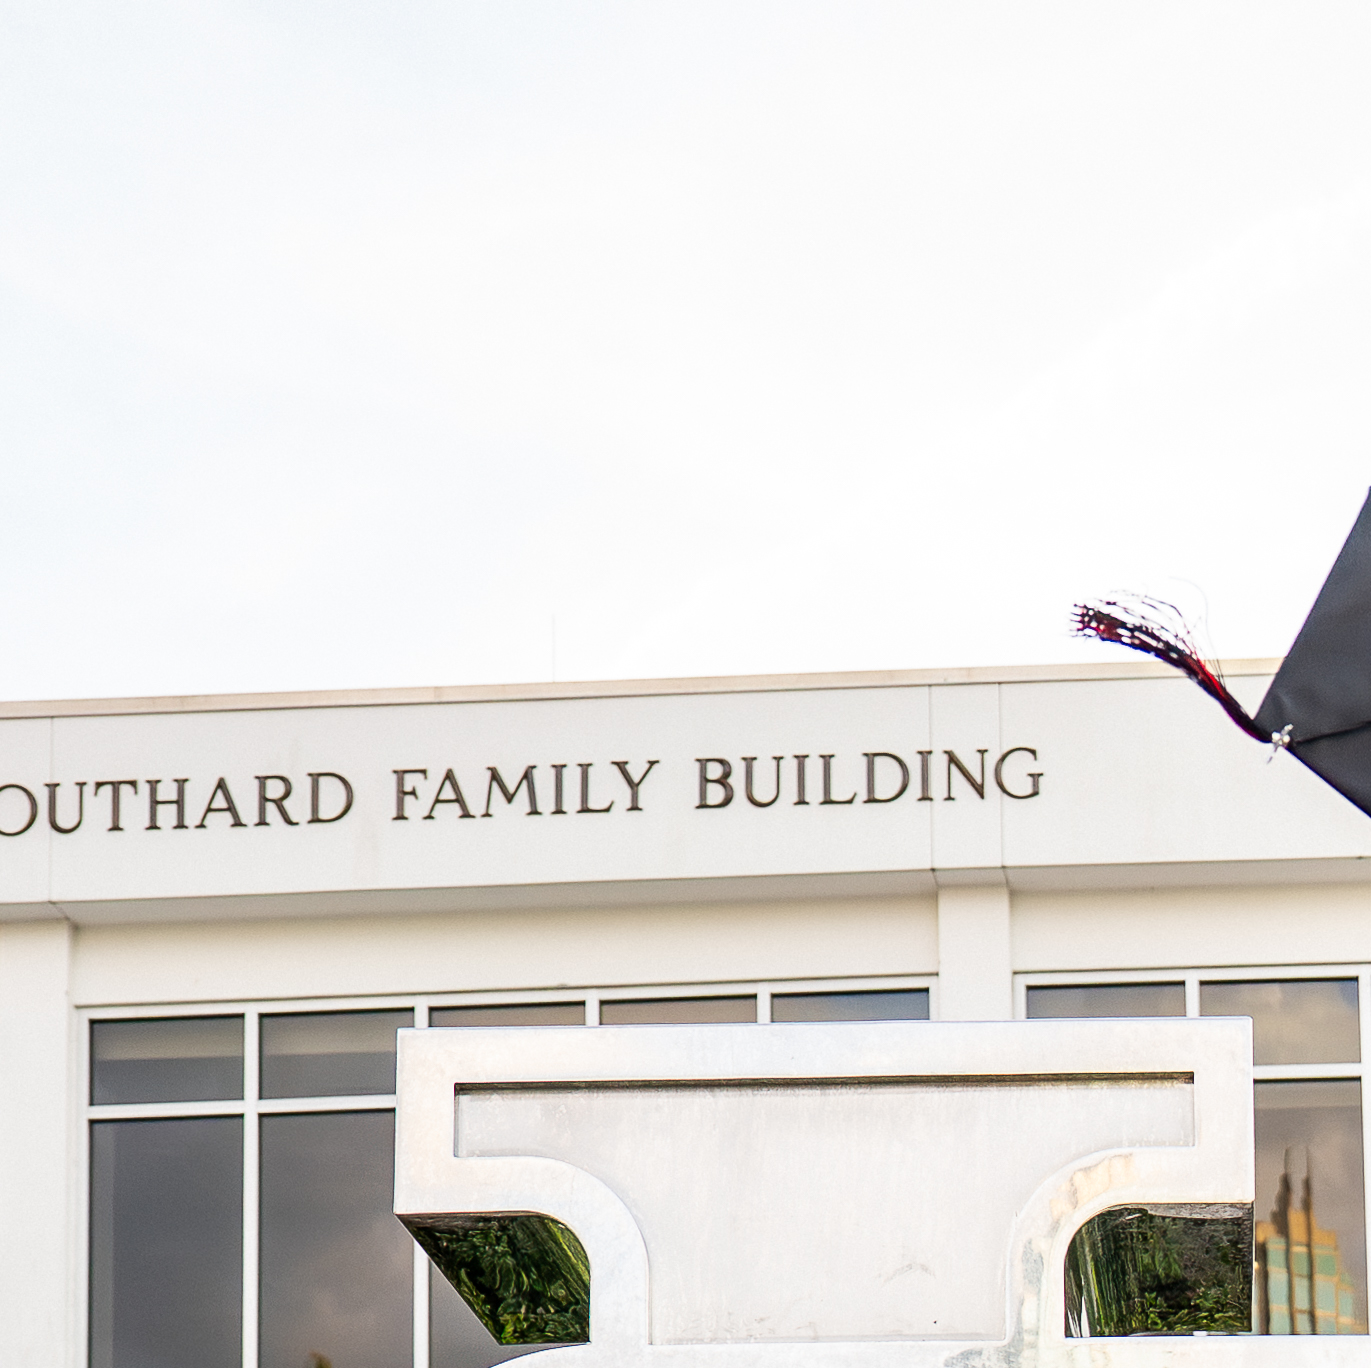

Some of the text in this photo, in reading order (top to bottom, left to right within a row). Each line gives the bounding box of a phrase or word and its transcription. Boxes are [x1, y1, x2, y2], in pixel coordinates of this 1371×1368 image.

[0, 746, 1045, 837] OUTHARD FAMILY BUILDING
